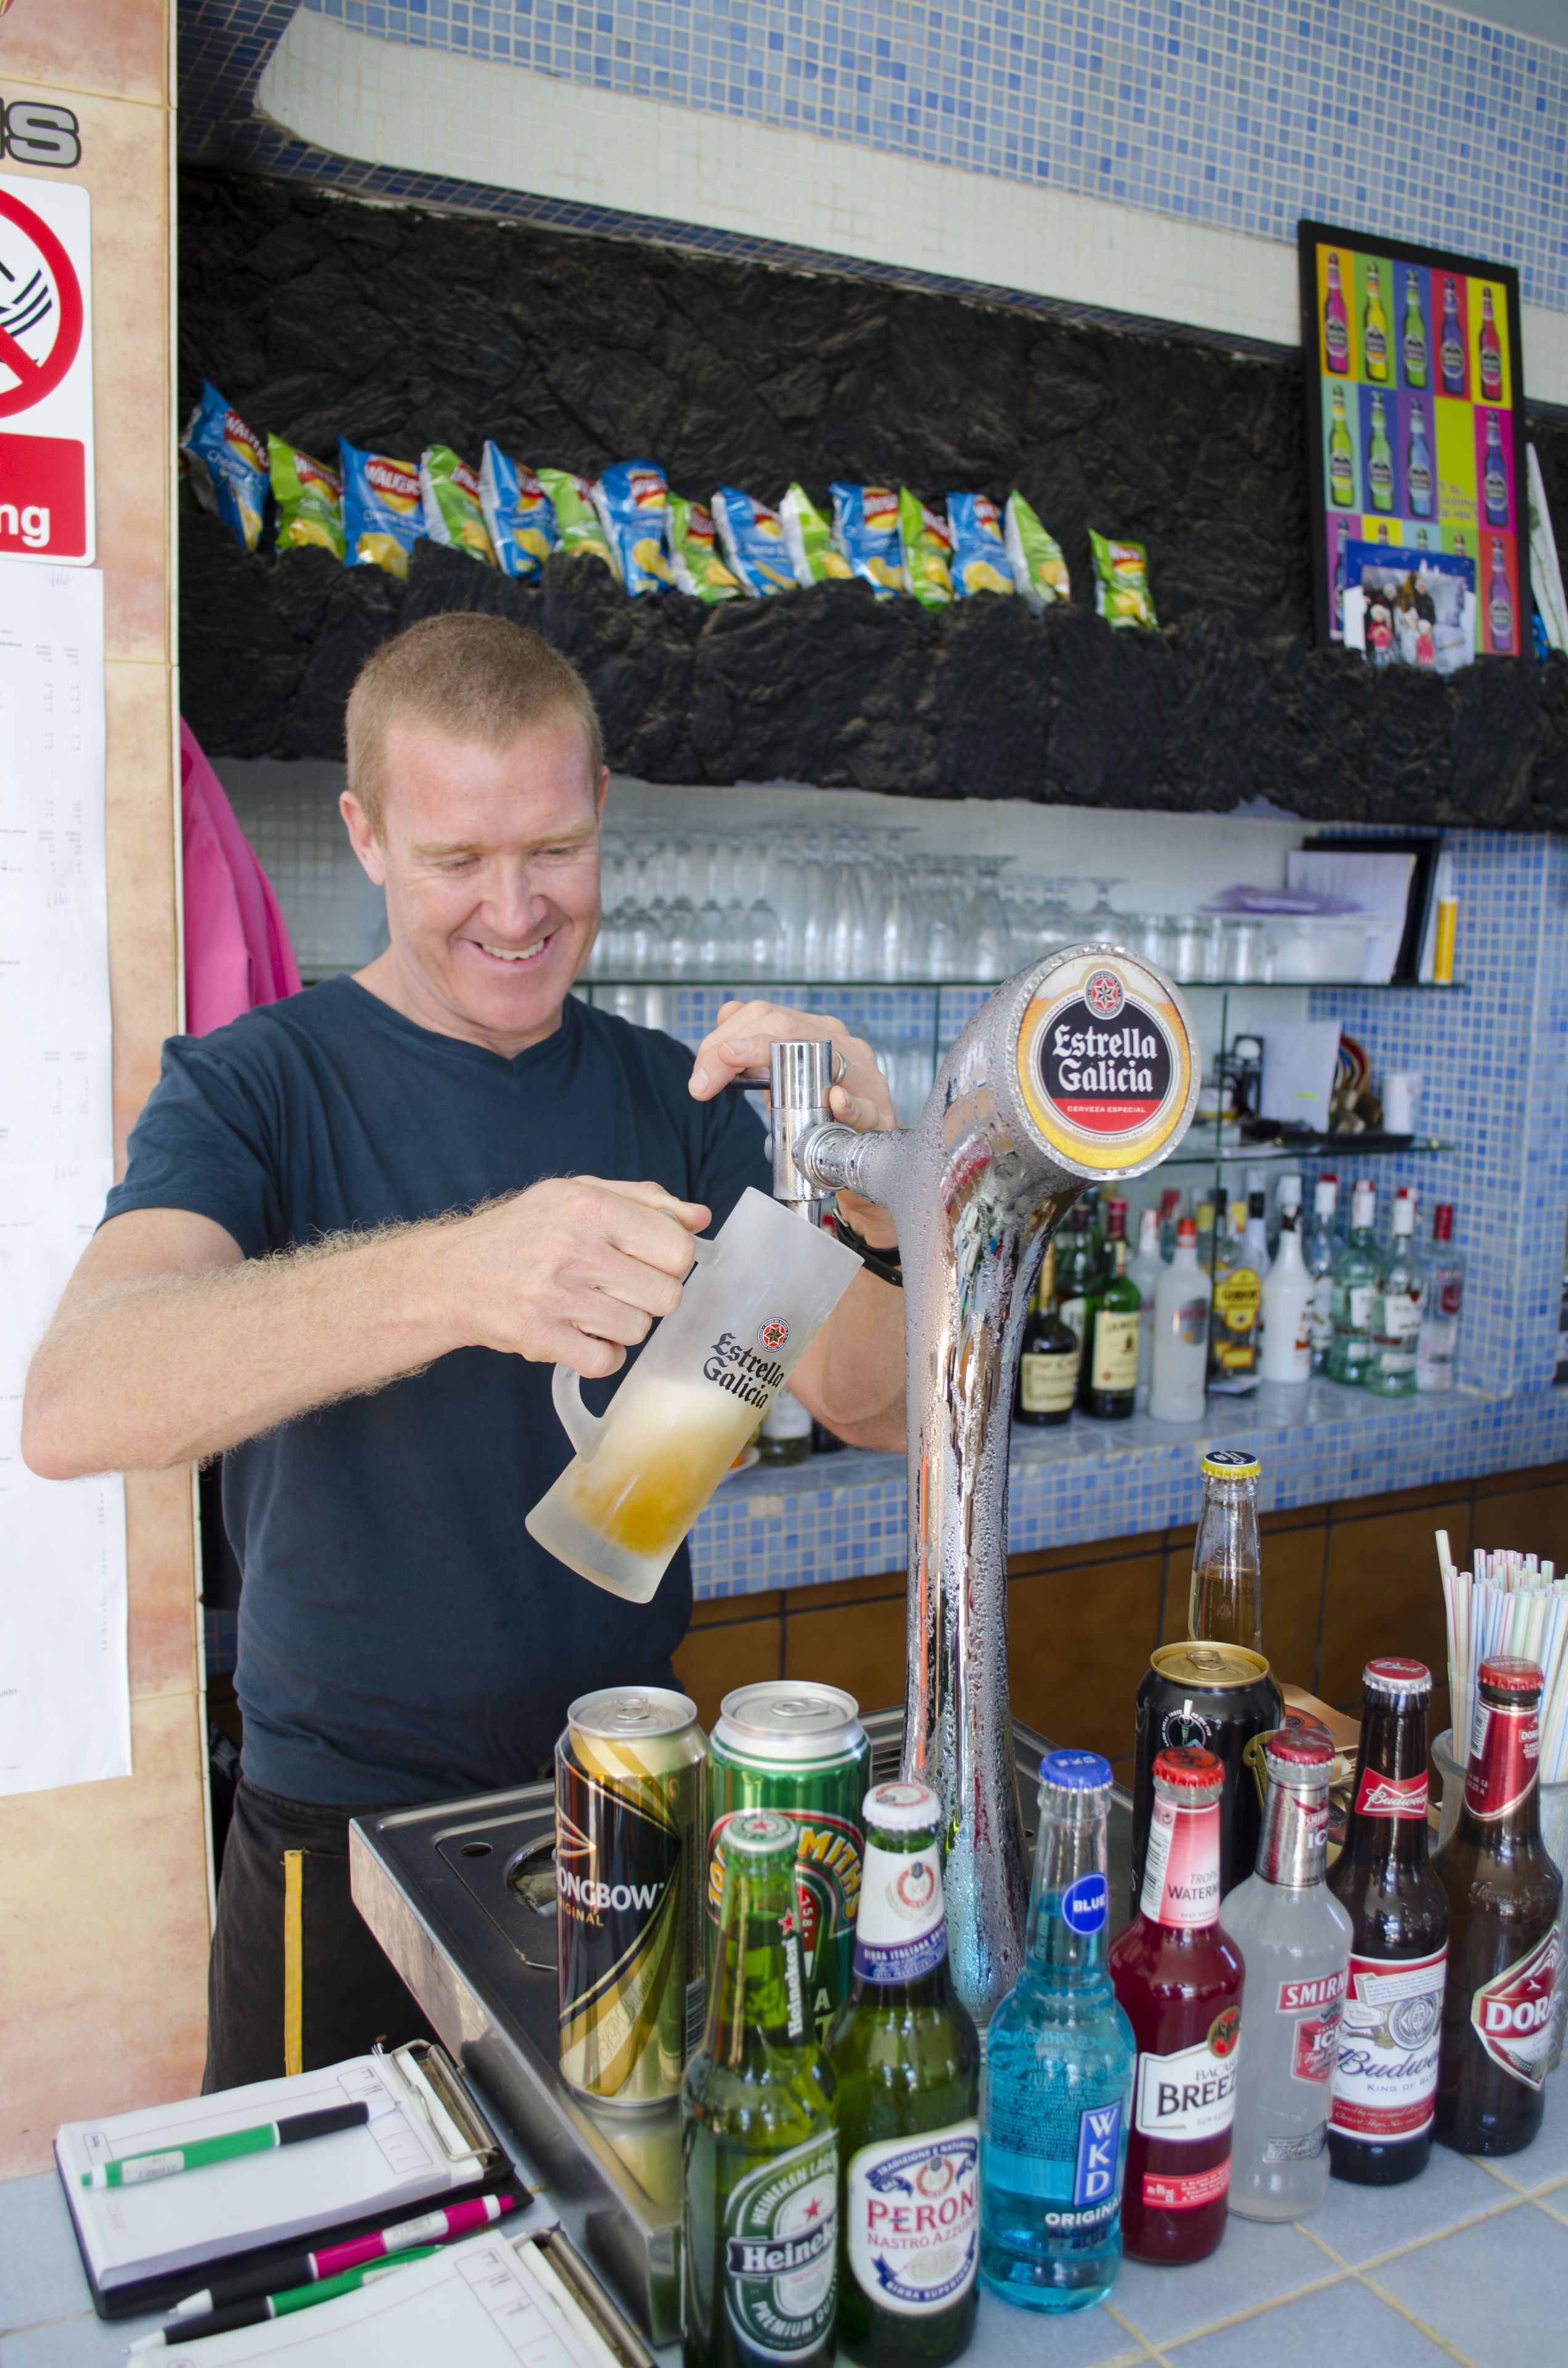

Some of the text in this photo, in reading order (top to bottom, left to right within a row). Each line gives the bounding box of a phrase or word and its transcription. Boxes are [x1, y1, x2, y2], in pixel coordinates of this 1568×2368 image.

[1052, 1024, 1158, 1059] Estrella
[1058, 1058, 1154, 1093] Galicia
[710, 1332, 785, 1389] Estrella
[703, 1356, 769, 1409] Galicia
[1073, 1893, 1105, 1912] BLUE
[782, 1935, 803, 2037] Heineken
[1367, 2083, 1397, 2092] KING
[1402, 2082, 1416, 2090] OF
[877, 2149, 932, 2176] TRADIZIONE
[1086, 2107, 1118, 2198] WKD
[750, 2166, 808, 2226] HEINEKEN
[1045, 2192, 1123, 2226] ORIGINA
[867, 2232, 930, 2250] NASTRO
[751, 2300, 813, 2338] PREMIUM
